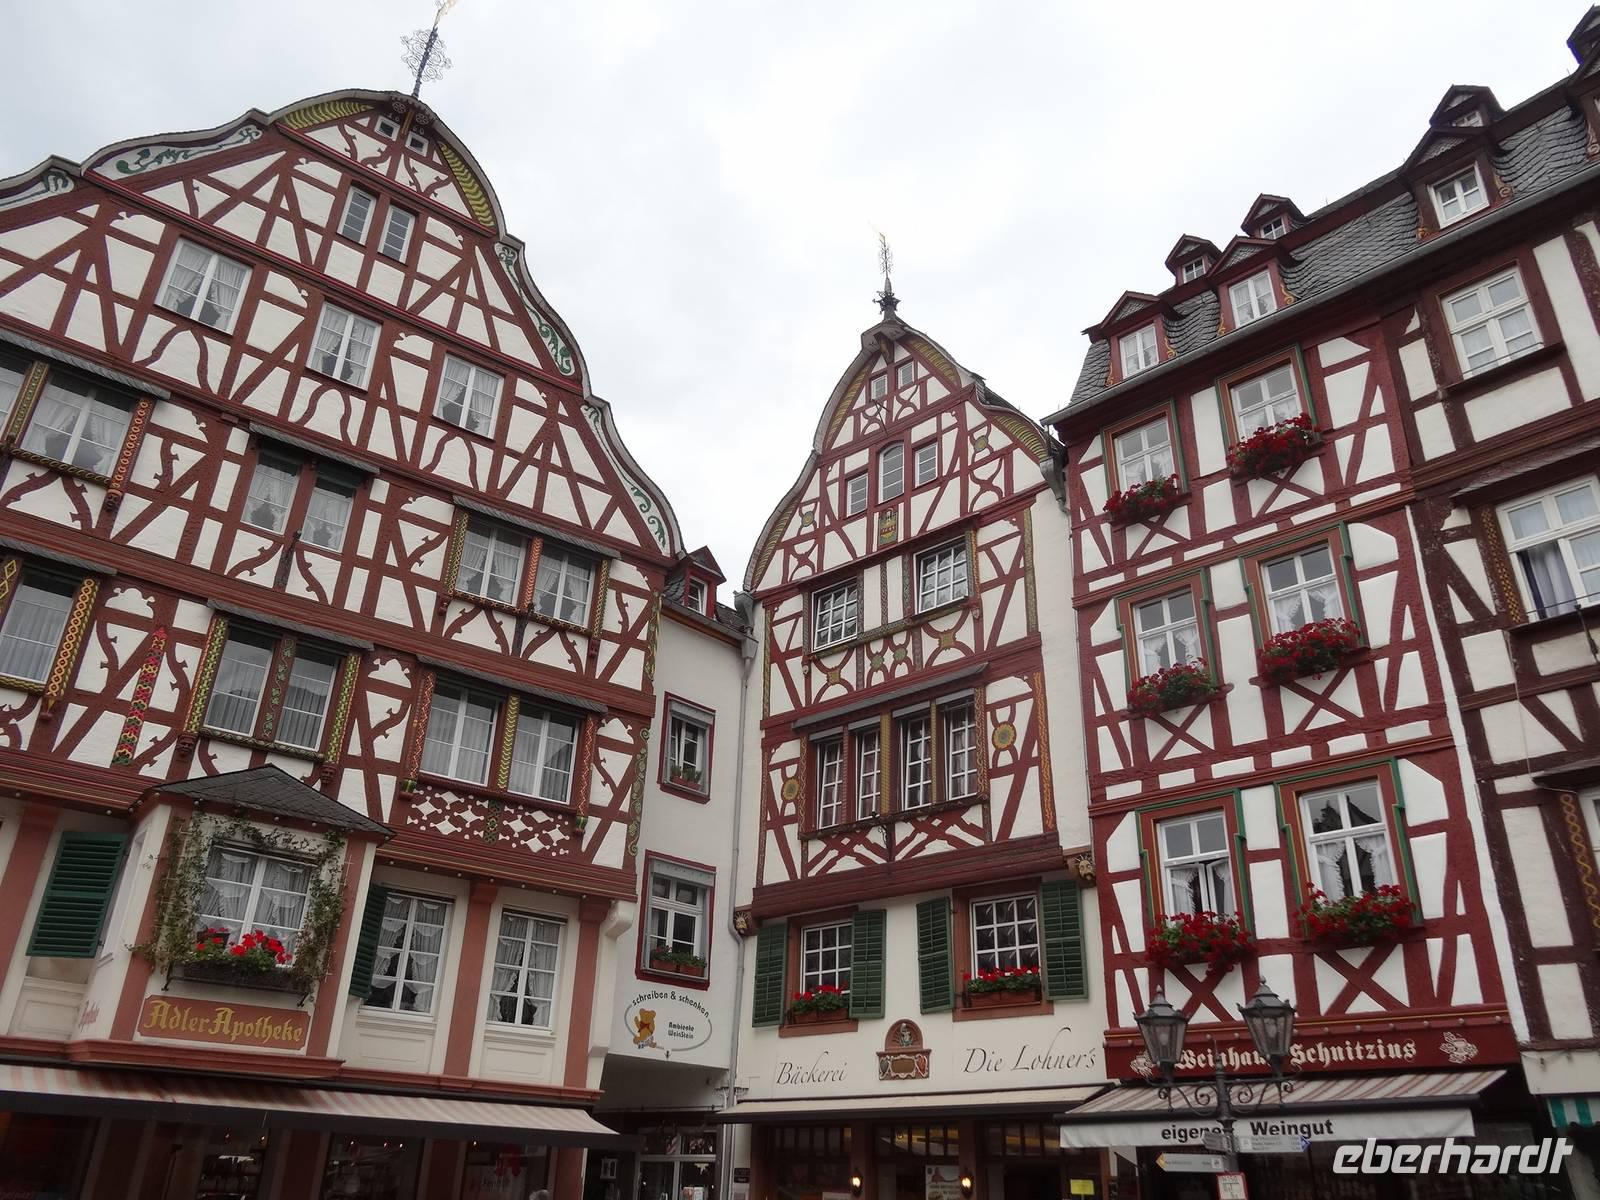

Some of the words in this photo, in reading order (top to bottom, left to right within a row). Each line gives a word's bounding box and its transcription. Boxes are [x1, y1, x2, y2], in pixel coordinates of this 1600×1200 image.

[143, 999, 211, 1034] Adler
[207, 1007, 304, 1044] Apotheke
[632, 990, 668, 1006] schreiben
[670, 991, 677, 1000] &
[678, 995, 709, 1018] schenken
[964, 1047, 1003, 1074] Die
[1010, 1026, 1097, 1071] Lohner's
[1289, 1038, 1417, 1073] Schnitzius
[776, 1050, 848, 1086] Bäckerei
[1250, 1118, 1334, 1139] Weingut
